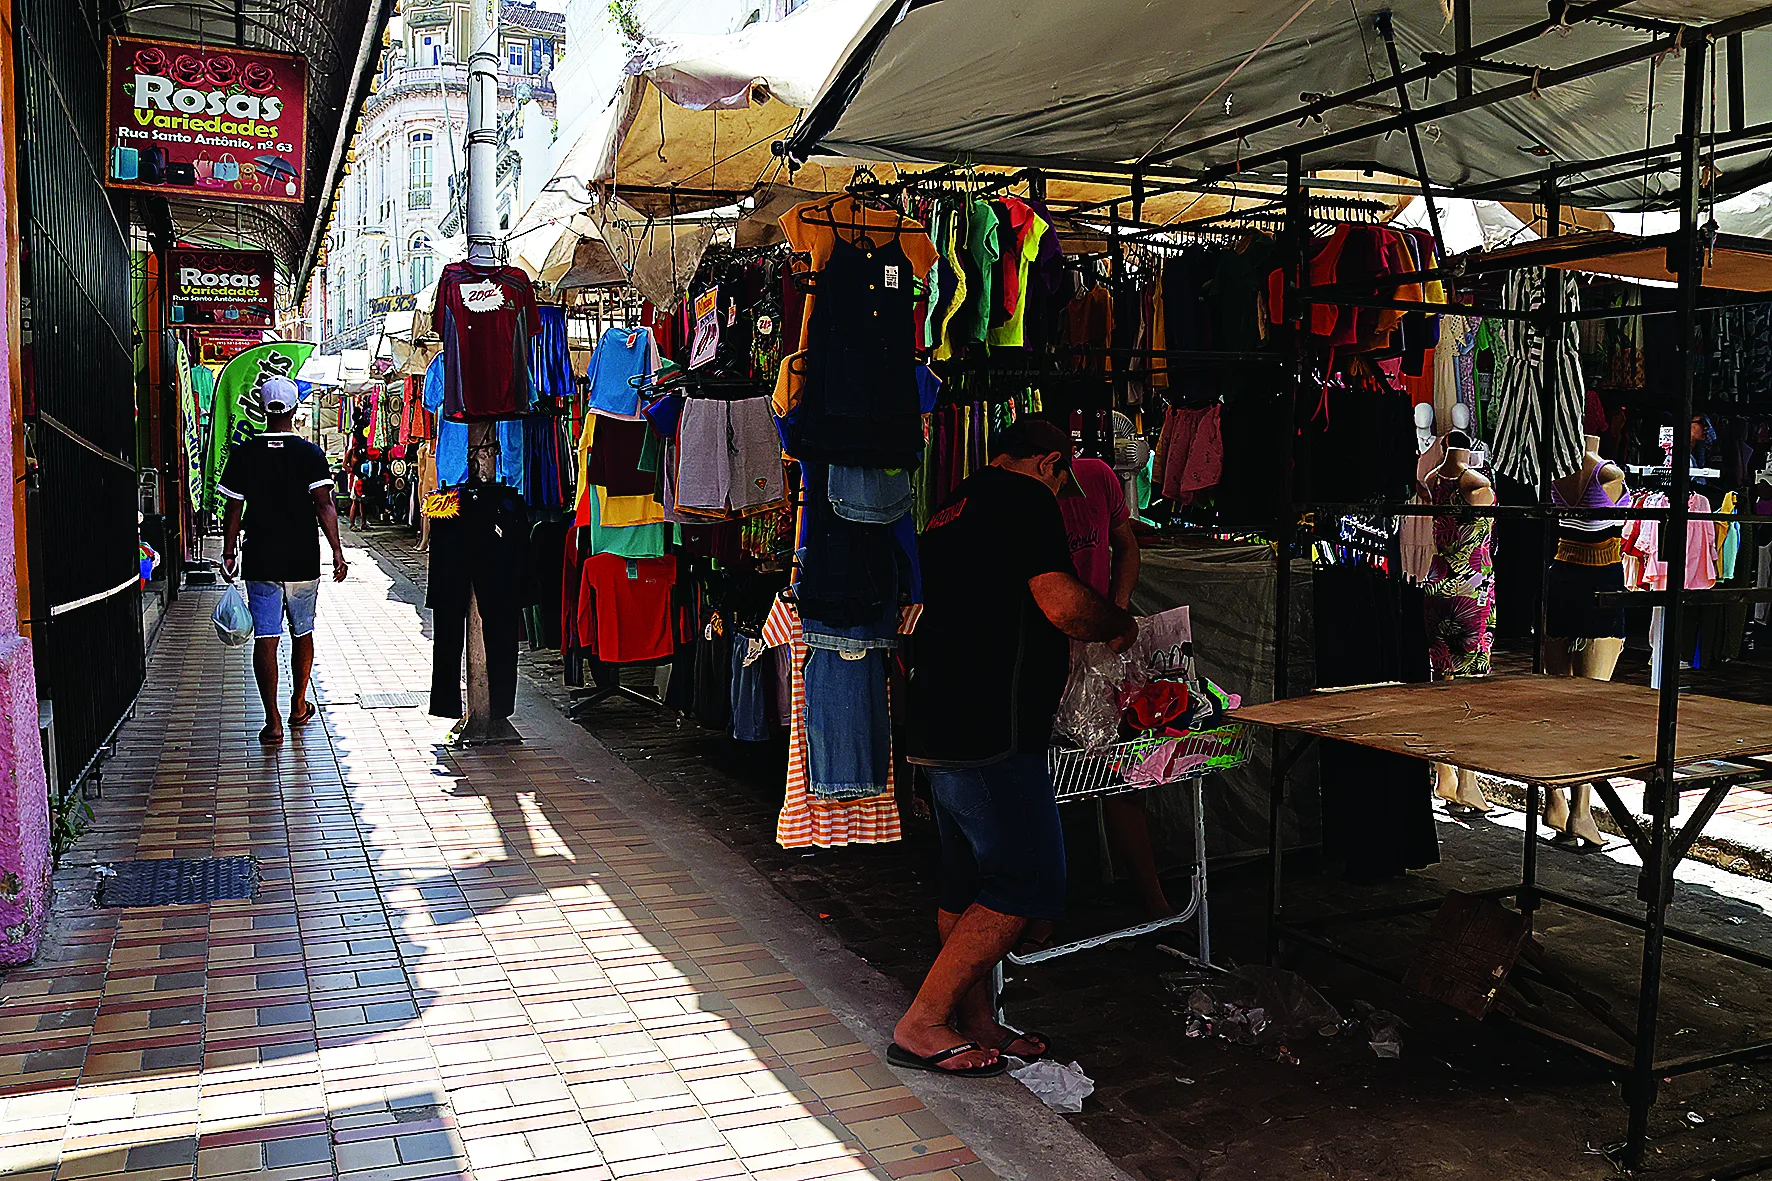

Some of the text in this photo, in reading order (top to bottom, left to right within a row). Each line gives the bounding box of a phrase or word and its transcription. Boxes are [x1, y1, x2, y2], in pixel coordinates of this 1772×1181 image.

[134, 74, 281, 121] Rosas
[134, 109, 279, 138] Variedades
[118, 126, 148, 139] Rua
[152, 130, 192, 143] Santo
[194, 133, 255, 151] Antônio,
[276, 142, 293, 153] 63
[180, 267, 261, 288] Rosas
[180, 285, 260, 297] Variedades
